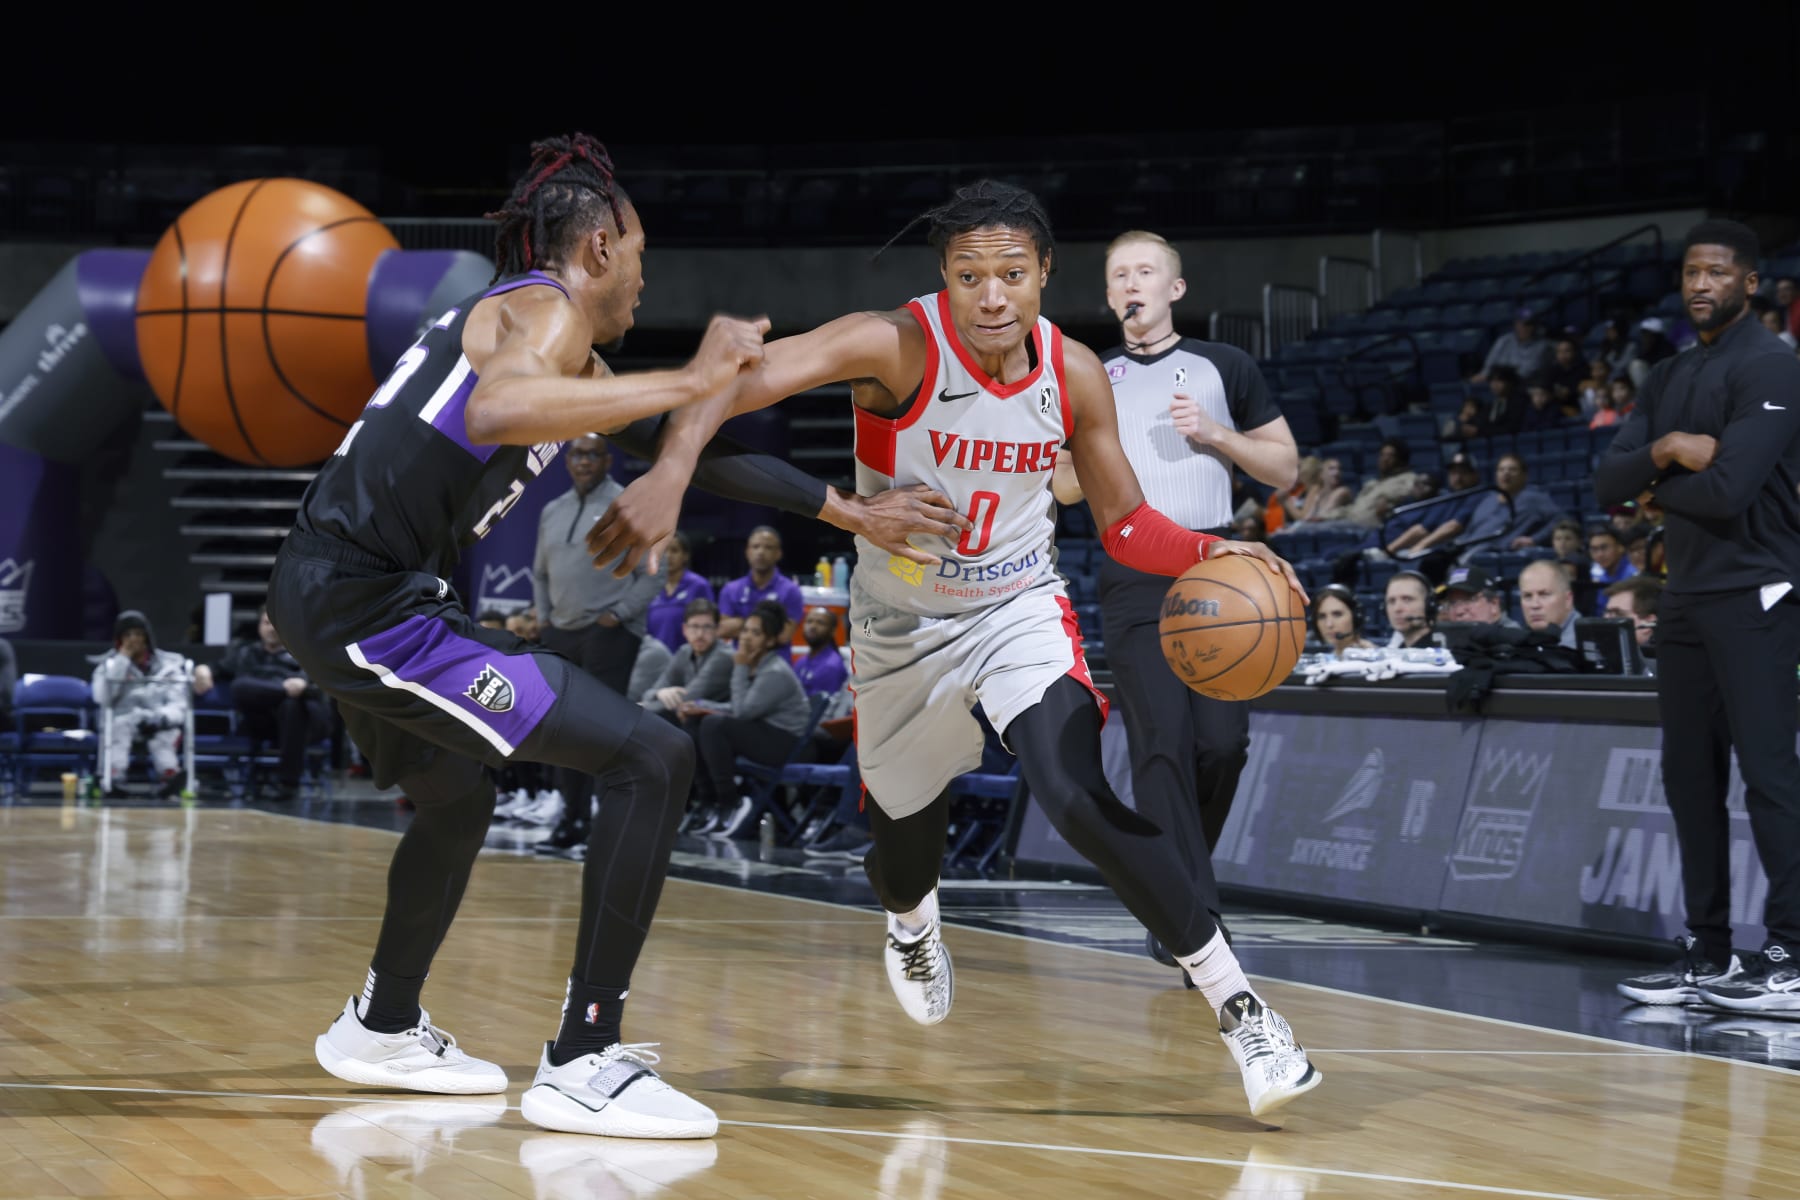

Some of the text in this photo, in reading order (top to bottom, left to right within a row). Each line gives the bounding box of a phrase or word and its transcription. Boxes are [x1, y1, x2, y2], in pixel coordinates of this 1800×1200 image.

[928, 429, 1060, 474] VIPERS
[957, 490, 1001, 556] 0
[933, 575, 1036, 598] Health System
[477, 677, 504, 706] 209
